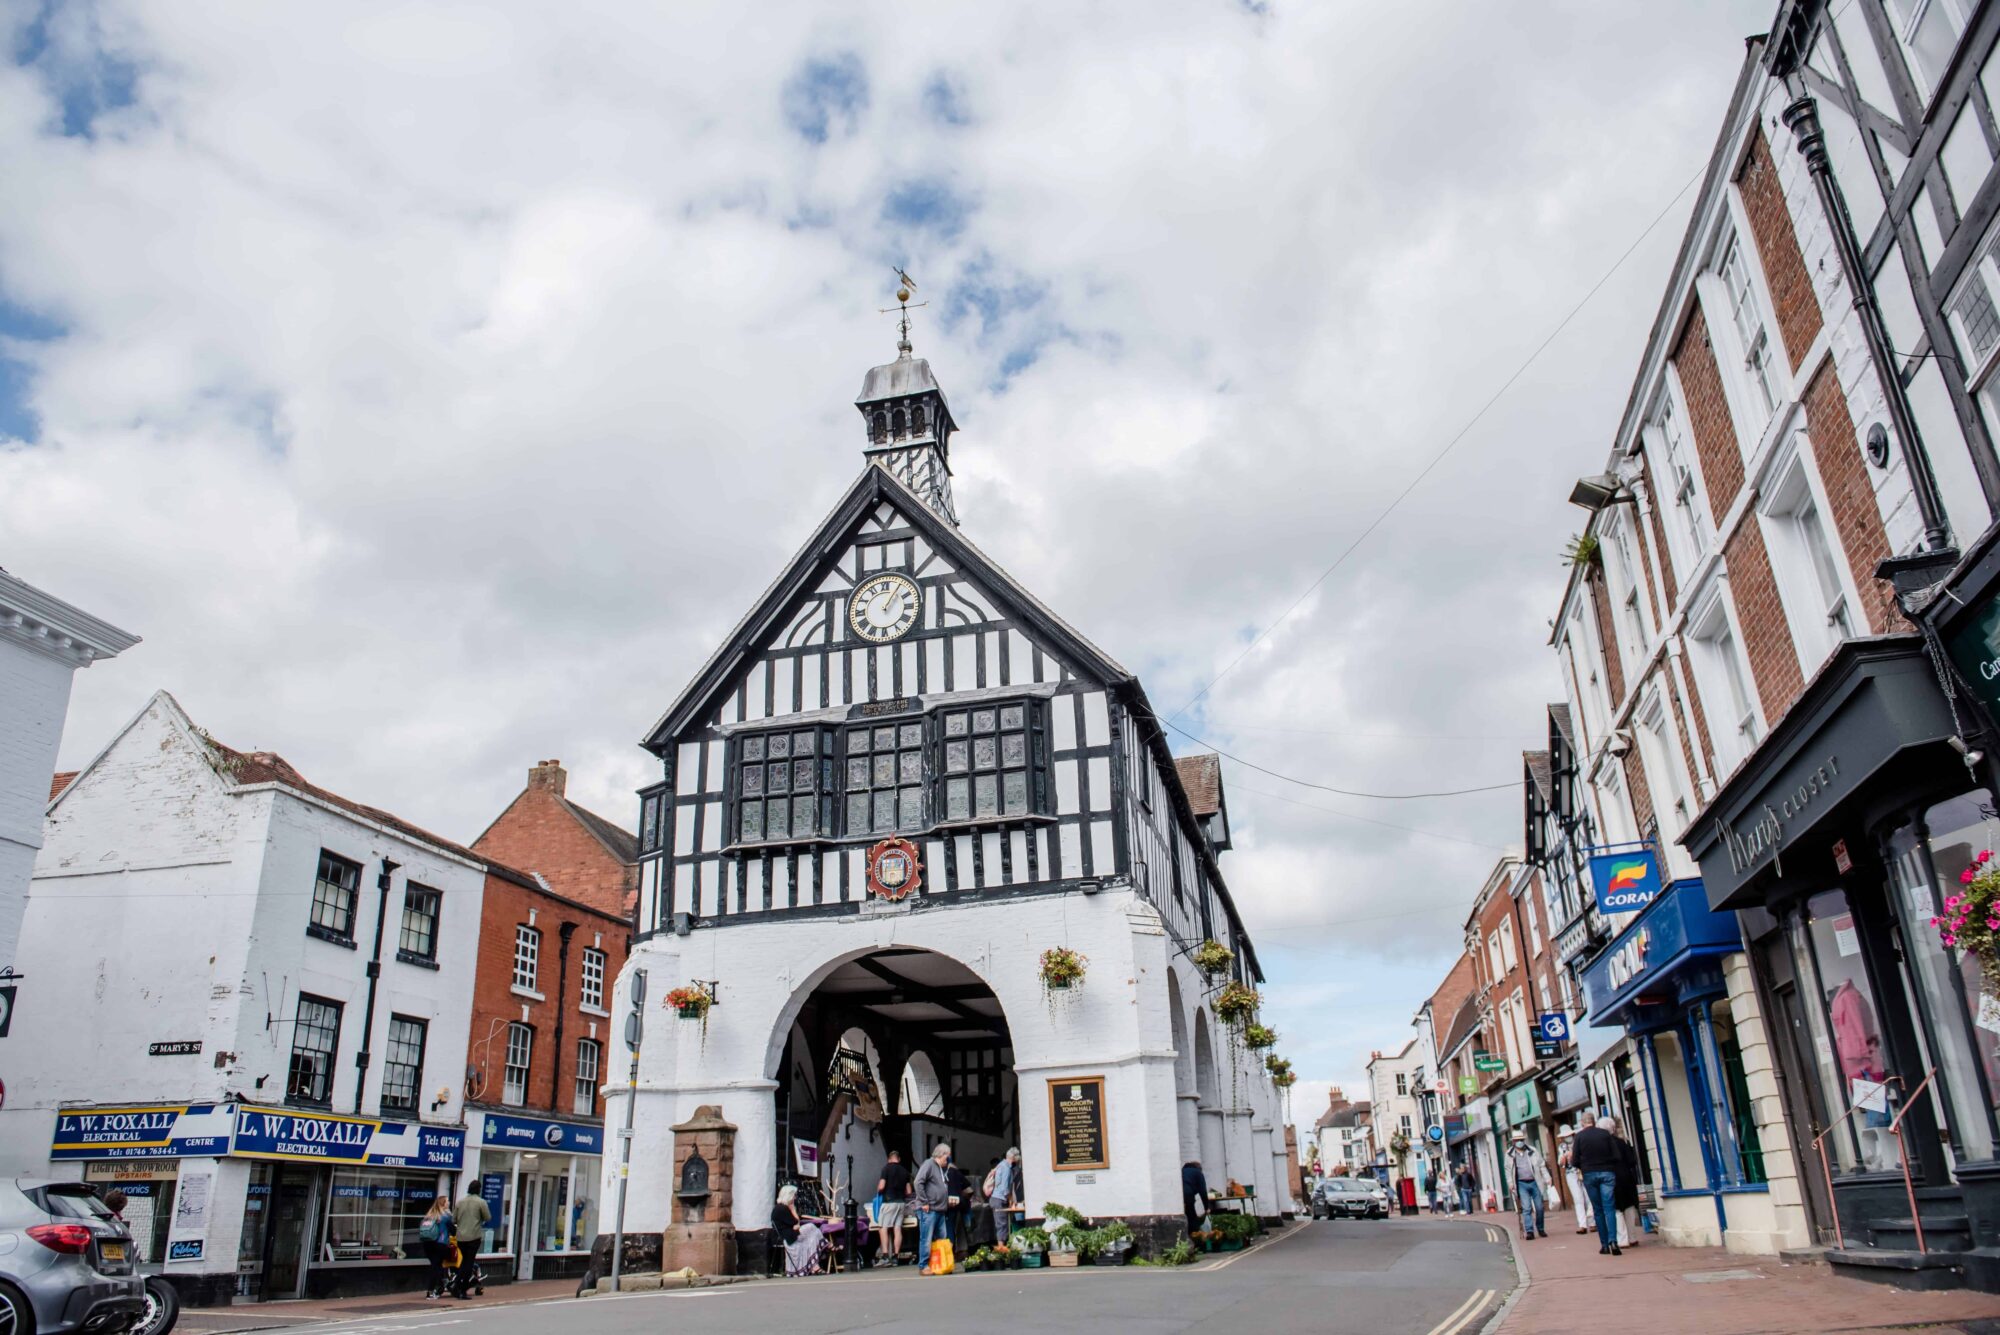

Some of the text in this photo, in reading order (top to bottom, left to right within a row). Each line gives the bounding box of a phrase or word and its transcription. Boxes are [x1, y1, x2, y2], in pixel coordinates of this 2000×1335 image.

[1784, 756, 1840, 818] CLOSET
[160, 1043, 190, 1052] MARY'S
[60, 1113, 174, 1132] L. W. FOXALL
[238, 1112, 368, 1146] L. W. FOXALL
[82, 1132, 140, 1142] ELECTRICAL
[425, 1134, 460, 1148] Tel: 01746
[506, 1126, 536, 1140] pharmacy
[576, 1133, 594, 1146] beauty
[186, 1138, 214, 1146] CENTRE
[108, 1147, 177, 1156] Tel: 01746 763442
[276, 1142, 328, 1156] ELECTRICAL
[384, 1156, 406, 1166] CENTRE
[427, 1152, 454, 1163] 763442
[92, 1162, 177, 1173] LIGHTING SHOWROOM
[340, 1188, 364, 1196] euronics
